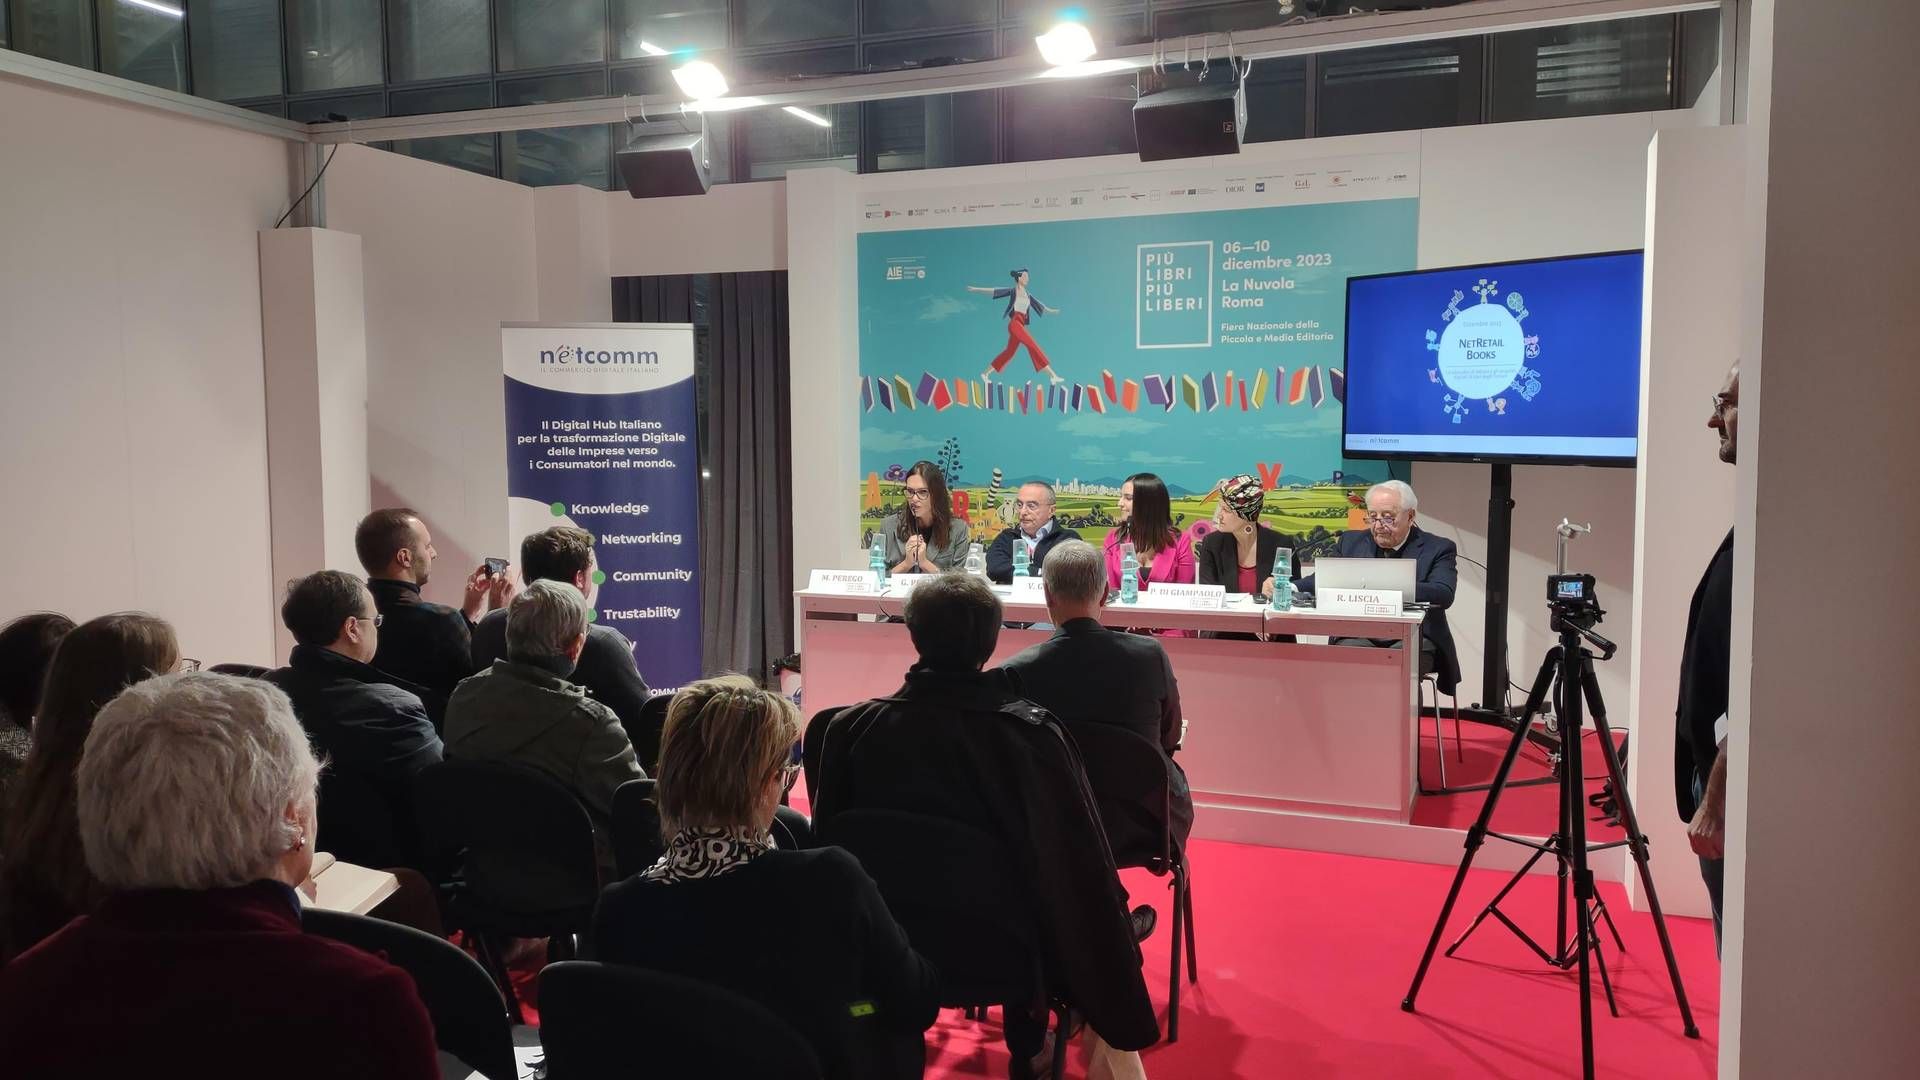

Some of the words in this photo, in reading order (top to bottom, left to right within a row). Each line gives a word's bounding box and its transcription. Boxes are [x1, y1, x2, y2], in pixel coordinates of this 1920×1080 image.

[1146, 252, 1174, 266] PIÙ
[1222, 256, 1292, 271] dicembre
[1296, 254, 1332, 267] 2023
[886, 266, 902, 277] AIE
[1146, 268, 1192, 281] LIBRI
[1146, 282, 1174, 296] PIÙ
[1222, 280, 1239, 292] La
[1244, 277, 1295, 290] Nuvola
[1146, 298, 1203, 311] LIBERI
[1222, 296, 1264, 308] Roma
[1221, 322, 1245, 331] Fiera
[1247, 321, 1293, 330] Nazionale
[1295, 320, 1319, 329] della
[1221, 334, 1254, 343] Piccola
[1264, 333, 1294, 342] Media
[1296, 332, 1334, 341] Editoria
[540, 345, 658, 364] netcomm
[542, 420, 548, 430] Il
[552, 420, 590, 432] Digital
[593, 420, 617, 430] Hub
[619, 420, 662, 430] Italiano
[517, 435, 537, 445] per
[540, 434, 550, 443] la
[552, 433, 639, 443] trasformazione
[642, 432, 686, 444] Digitale
[547, 446, 576, 456] delle
[578, 446, 625, 458] Imprese
[627, 447, 658, 455] verso
[536, 459, 610, 470] Consumatori
[612, 459, 630, 468] nel
[633, 458, 676, 468] mondo.
[571, 503, 649, 516] Knowledge
[601, 532, 682, 545] Networking
[613, 569, 692, 582] Community
[821, 574, 831, 582] M.
[1337, 594, 1346, 602] R.
[1348, 594, 1380, 603] LISCIA
[603, 607, 681, 620] Trustability
